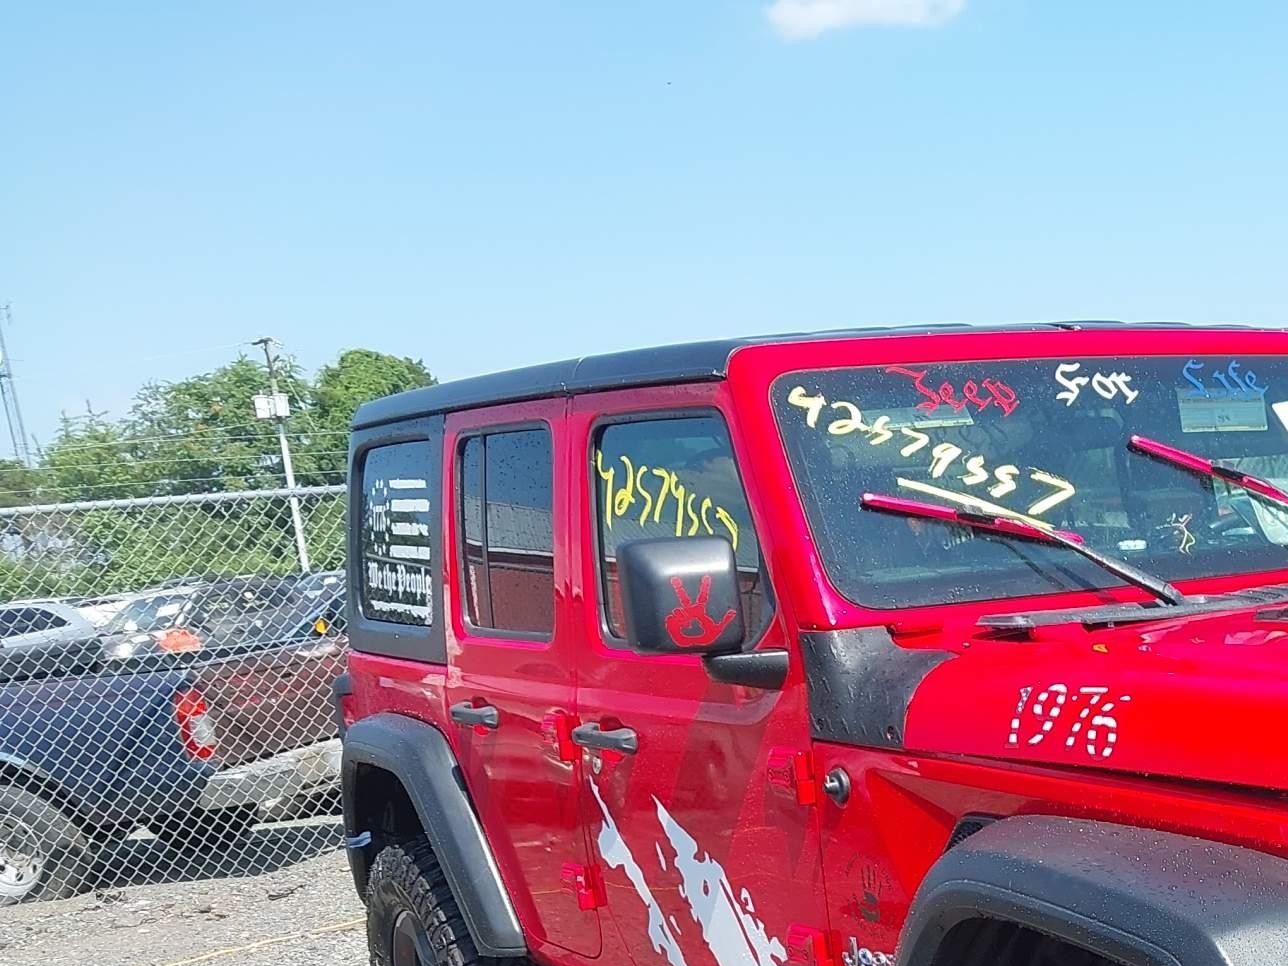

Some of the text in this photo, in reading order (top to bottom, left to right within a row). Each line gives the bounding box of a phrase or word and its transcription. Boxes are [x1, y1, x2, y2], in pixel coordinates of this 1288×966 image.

[886, 360, 1269, 416] Jeep For Life
[383, 563, 397, 596] the
[396, 564, 432, 600] People
